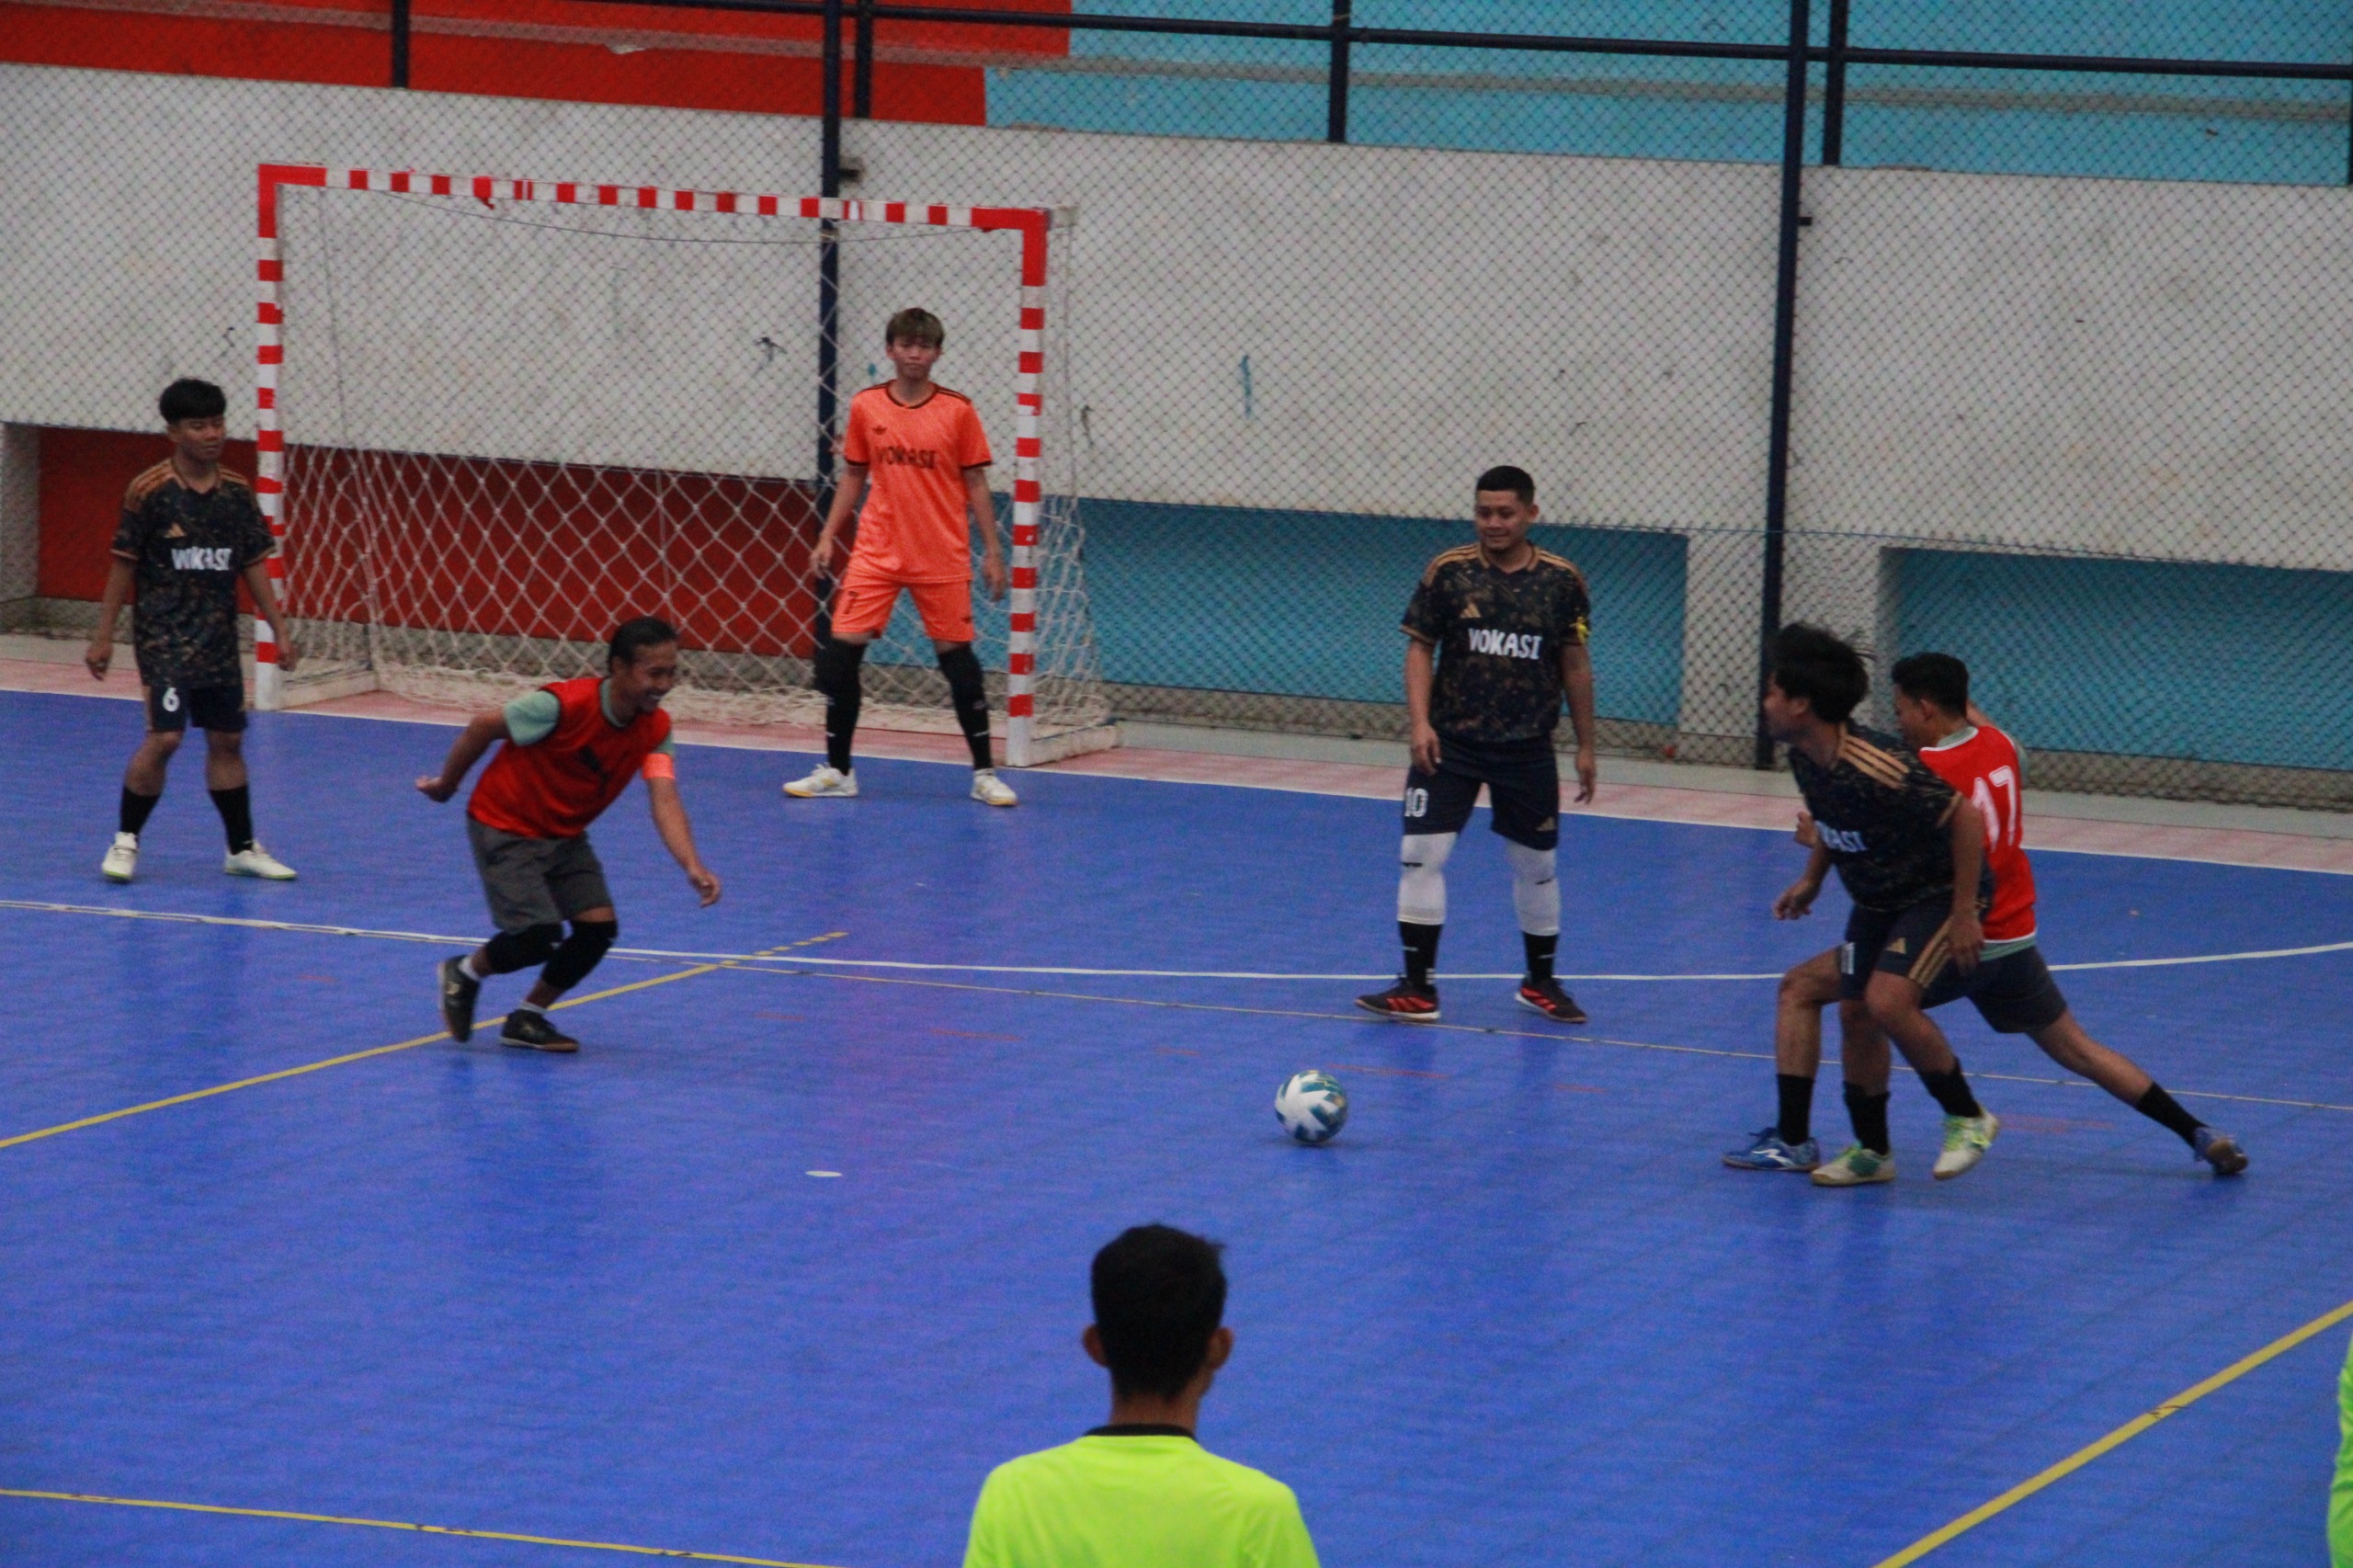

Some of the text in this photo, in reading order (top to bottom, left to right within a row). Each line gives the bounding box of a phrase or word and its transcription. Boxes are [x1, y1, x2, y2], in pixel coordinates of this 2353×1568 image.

[1469, 629, 1540, 659] VOKASI
[163, 687, 180, 711] 6
[1404, 788, 1428, 817] 10
[1971, 765, 2017, 853] 17
